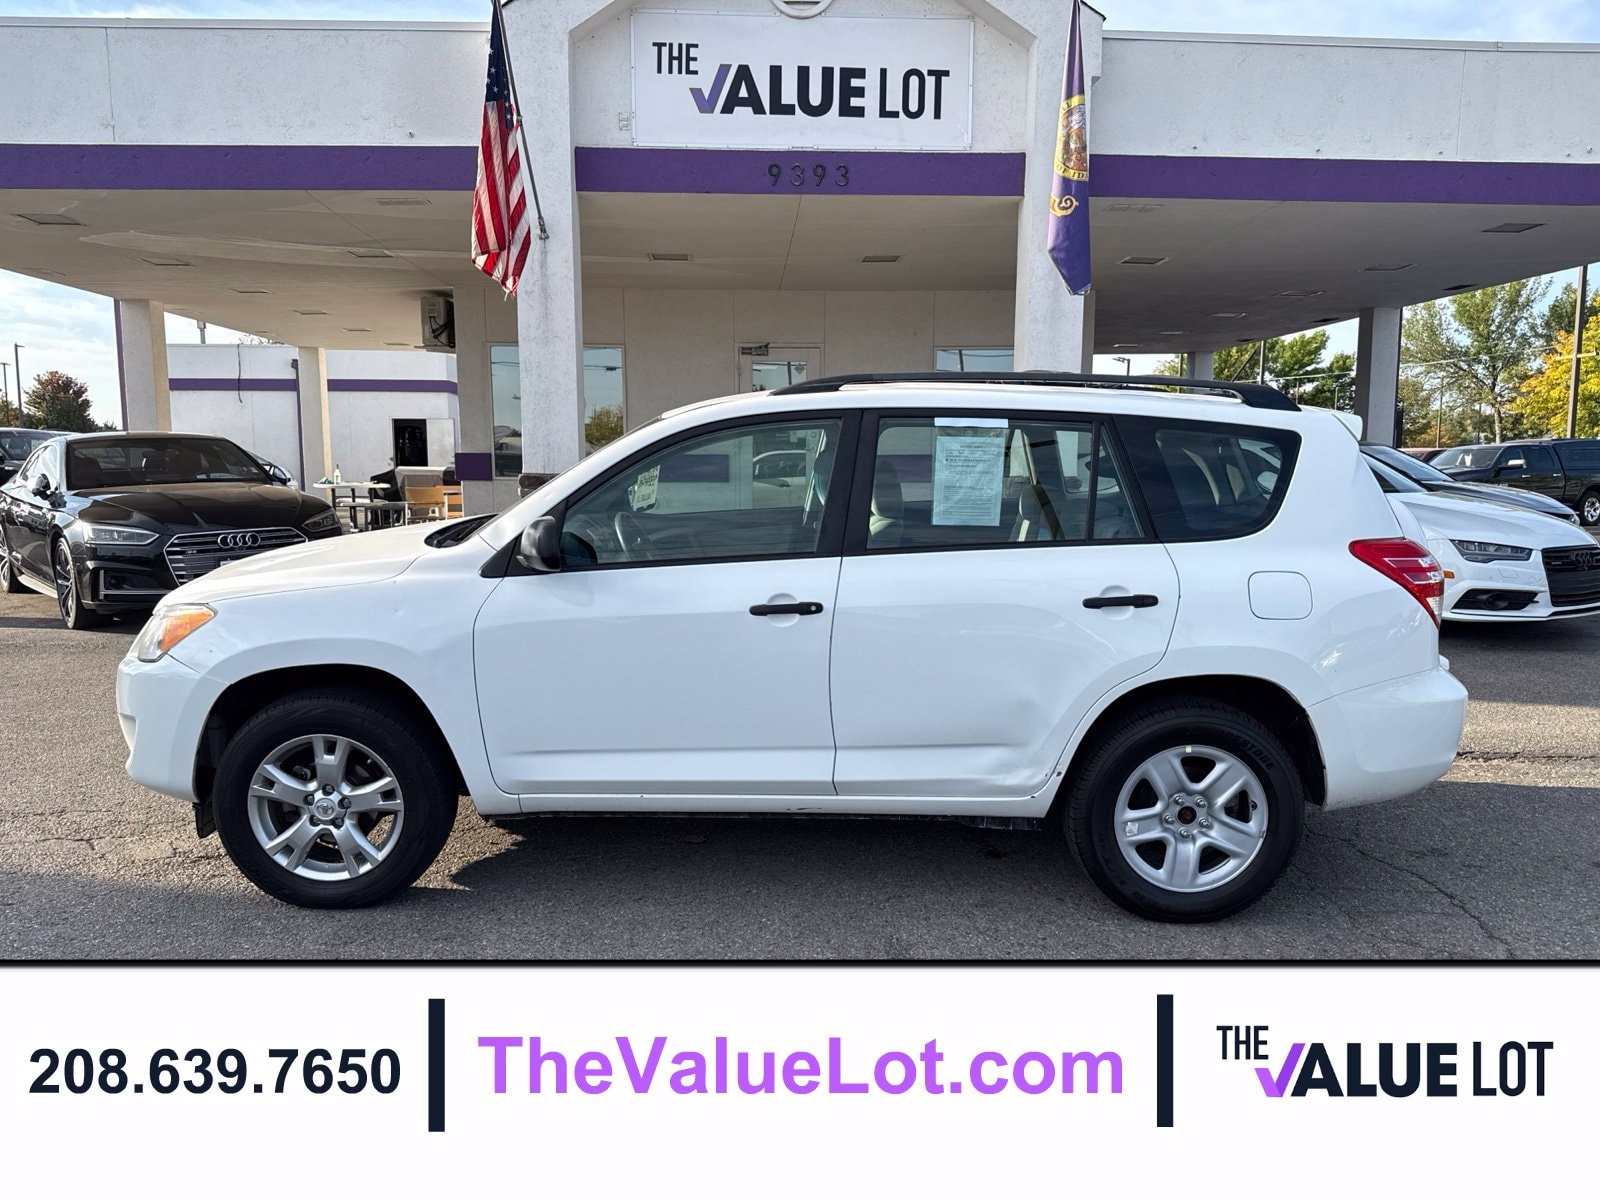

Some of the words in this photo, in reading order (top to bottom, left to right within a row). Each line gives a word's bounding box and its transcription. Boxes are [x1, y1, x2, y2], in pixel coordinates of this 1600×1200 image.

[652, 42, 699, 75] THE
[689, 64, 867, 118] VALUE
[879, 68, 950, 120] LOT
[767, 162, 850, 187] 9393
